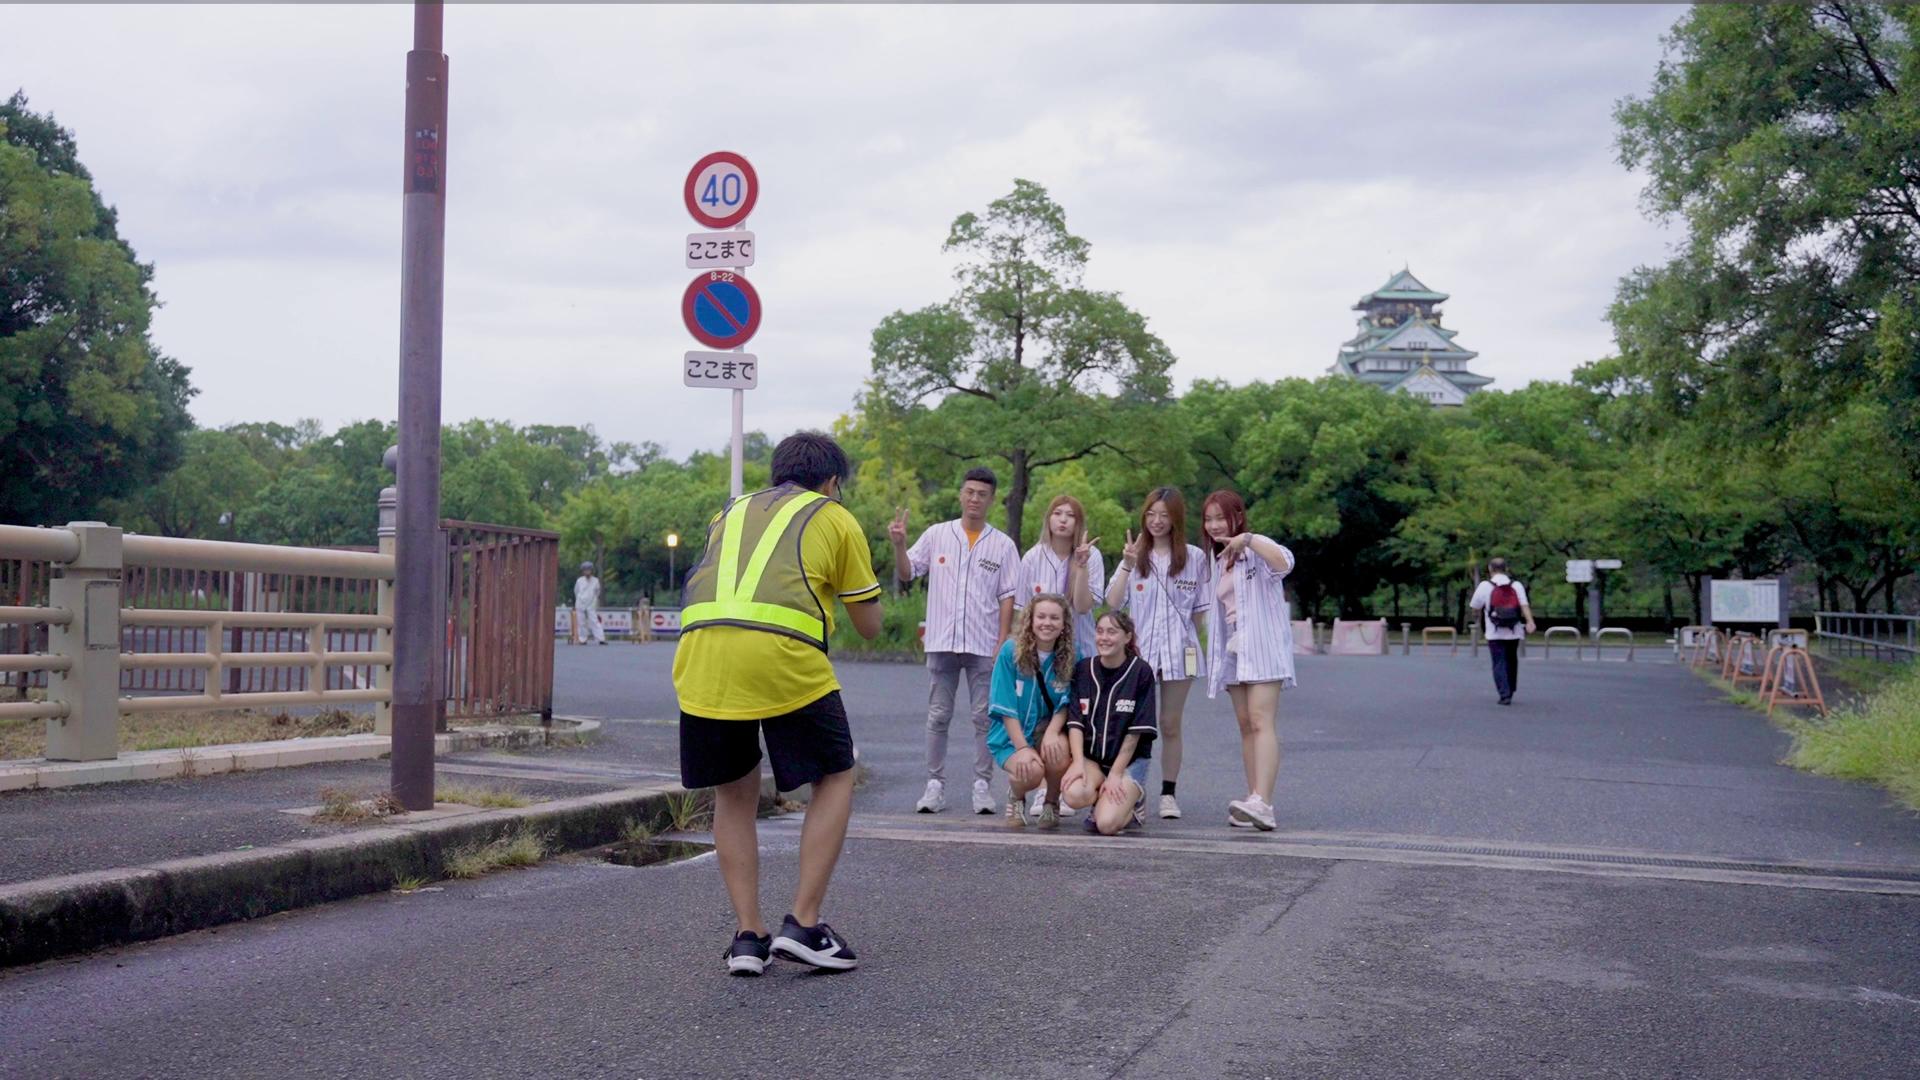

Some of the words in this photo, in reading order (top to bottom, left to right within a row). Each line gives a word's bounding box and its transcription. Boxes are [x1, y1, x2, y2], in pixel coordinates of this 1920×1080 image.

[700, 172, 741, 207] 40
[688, 239, 752, 260] ここまで
[710, 271, 734, 283] 8-22
[687, 359, 755, 381] ここまで
[1115, 705, 1135, 713] KAR
